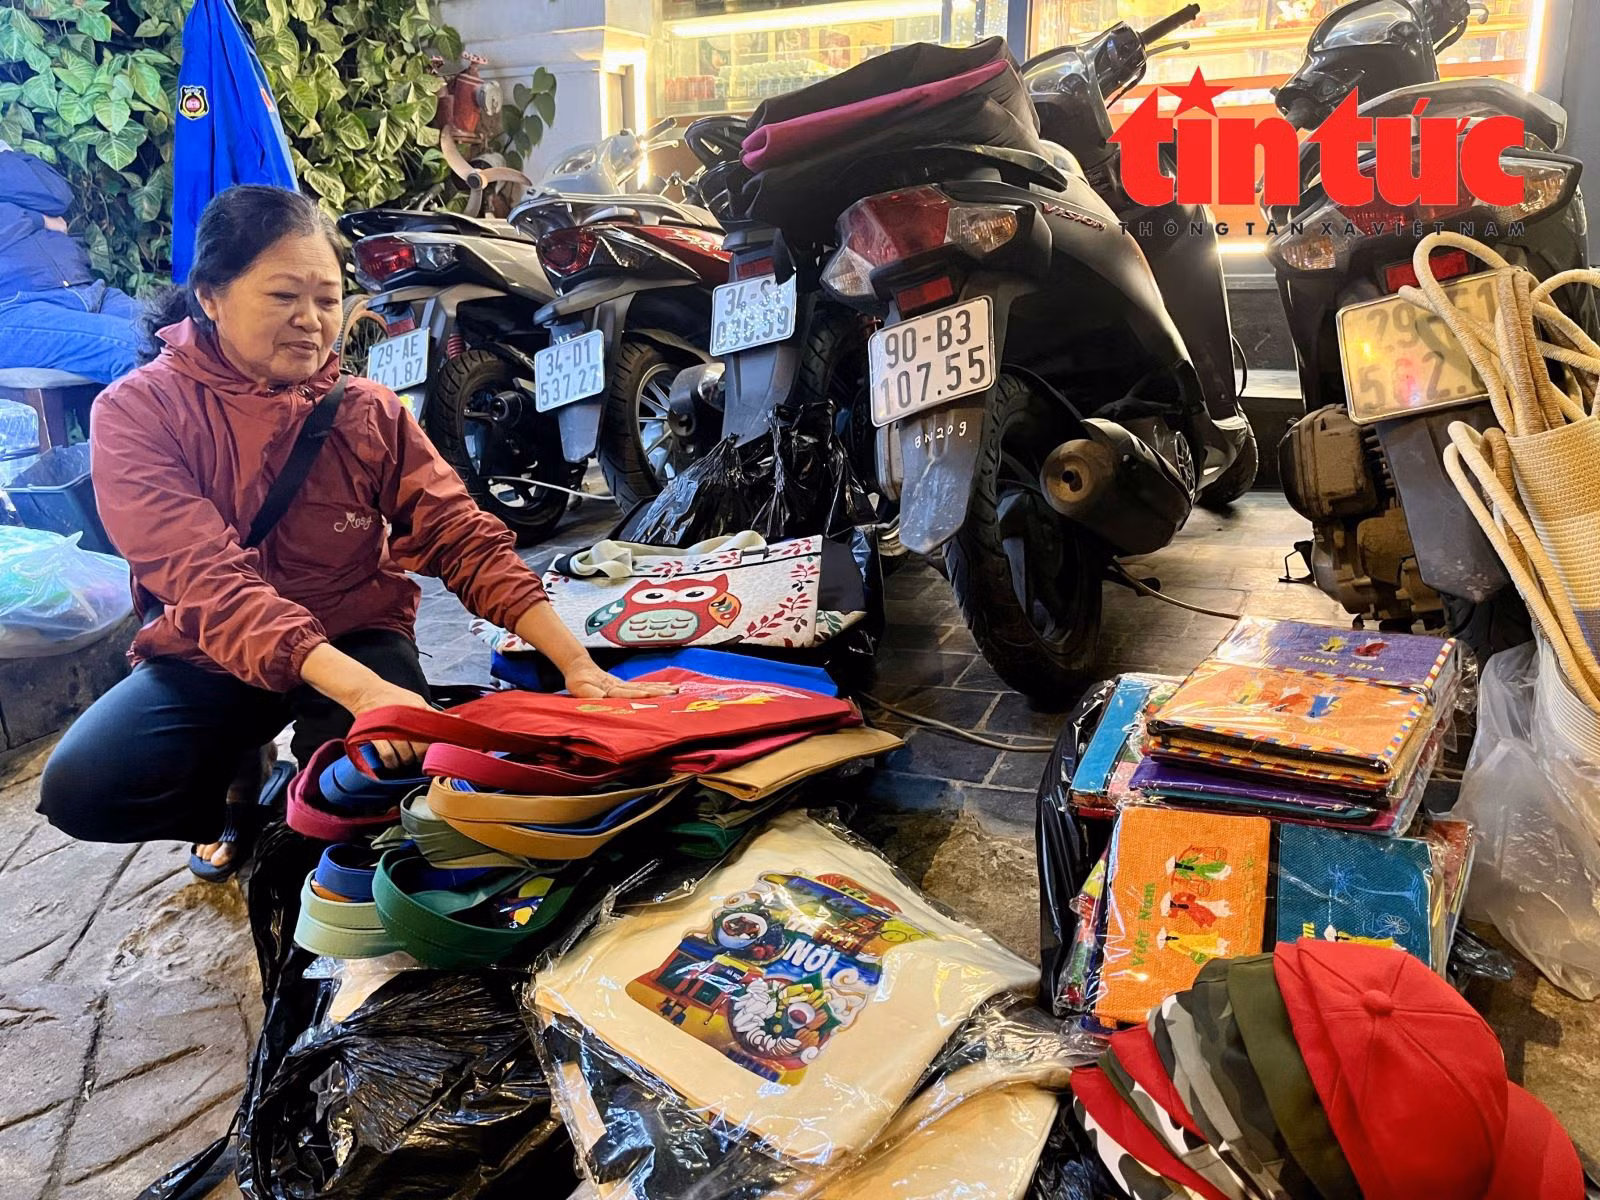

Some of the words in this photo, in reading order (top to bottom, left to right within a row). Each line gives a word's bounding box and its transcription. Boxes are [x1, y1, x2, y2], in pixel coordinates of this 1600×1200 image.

[1040, 200, 1108, 231] VISION
[377, 334, 420, 369] 29-AE
[546, 339, 591, 377] 34-D1
[884, 309, 971, 369] 90-B3
[540, 363, 600, 407] 537.27
[880, 345, 986, 416] 107.55
